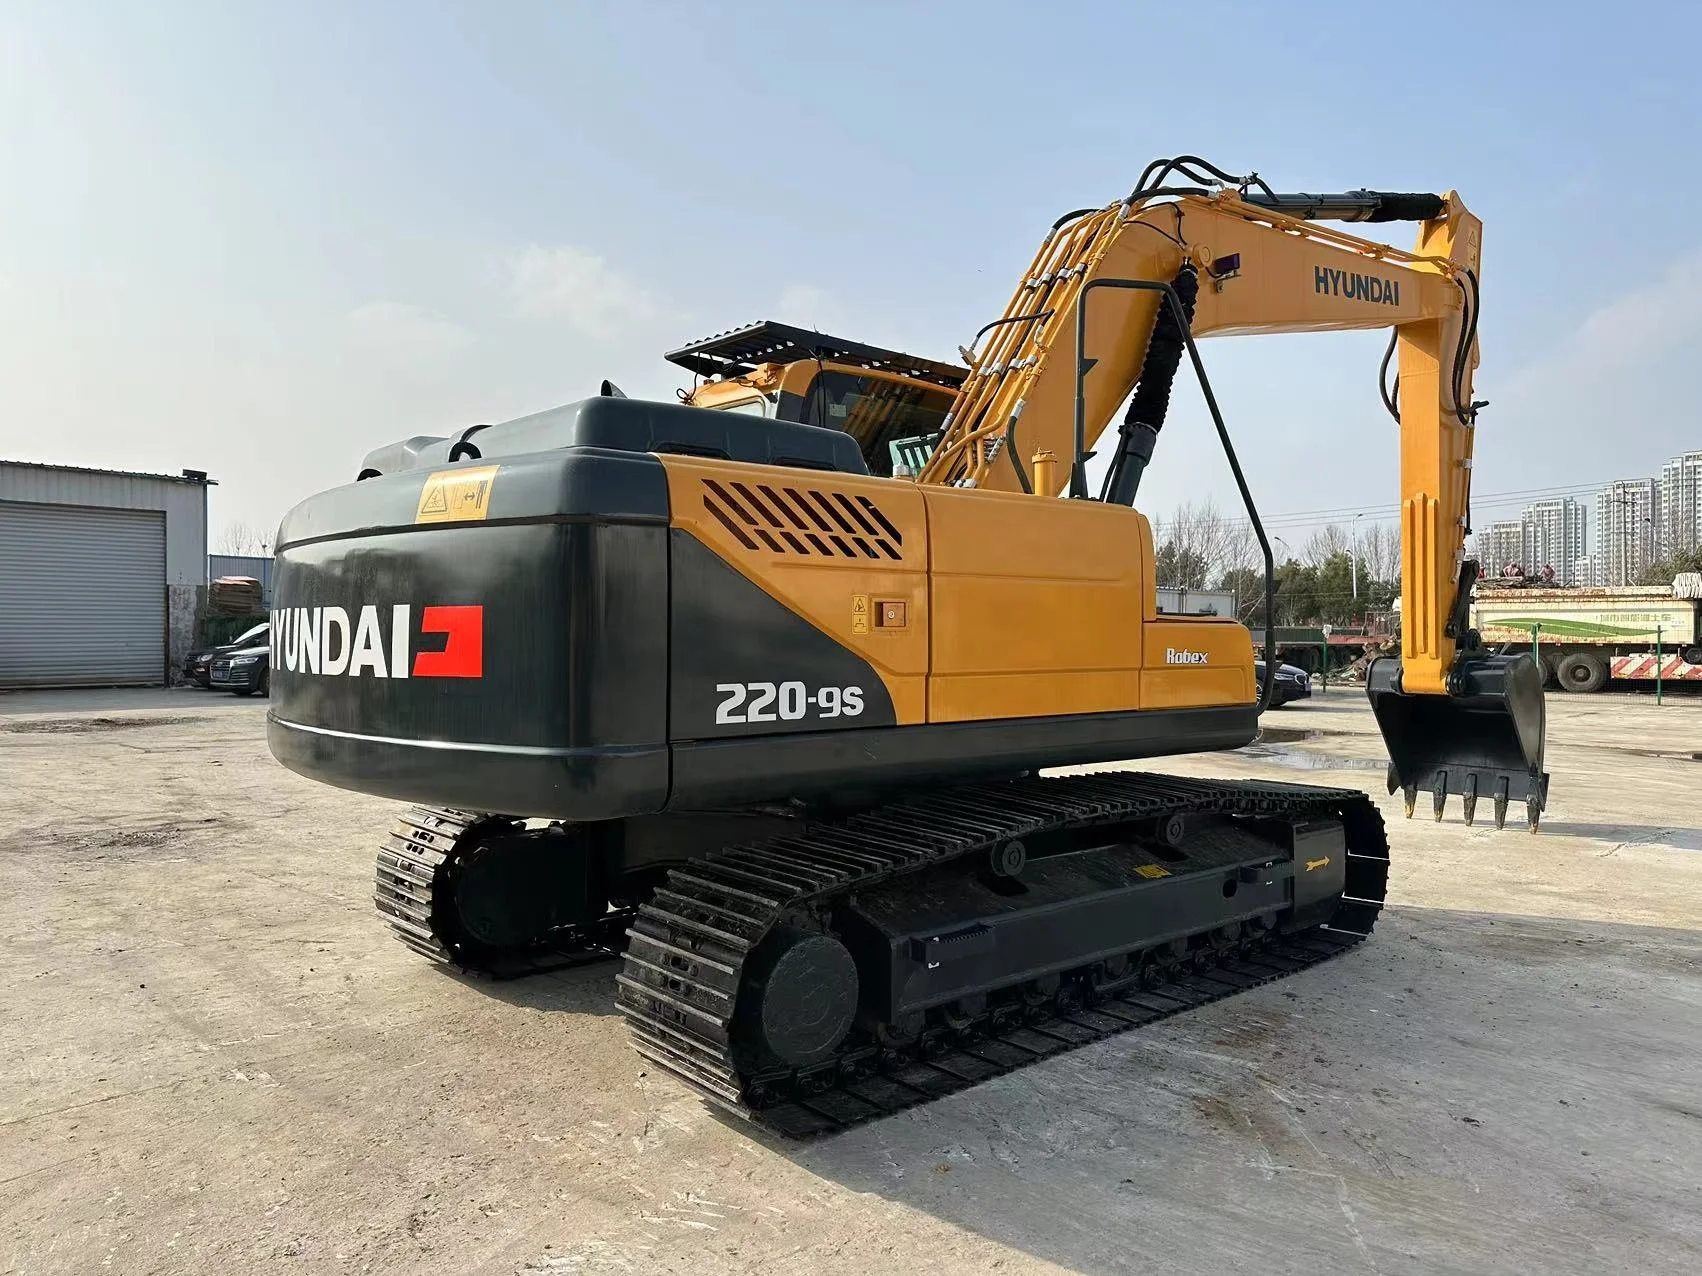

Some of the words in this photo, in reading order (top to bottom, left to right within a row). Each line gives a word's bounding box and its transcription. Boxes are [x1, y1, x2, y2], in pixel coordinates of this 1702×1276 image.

[1314, 265, 1400, 307] HYUNDAI
[269, 604, 411, 679] HYUNDAI
[1166, 647, 1209, 664] Robex
